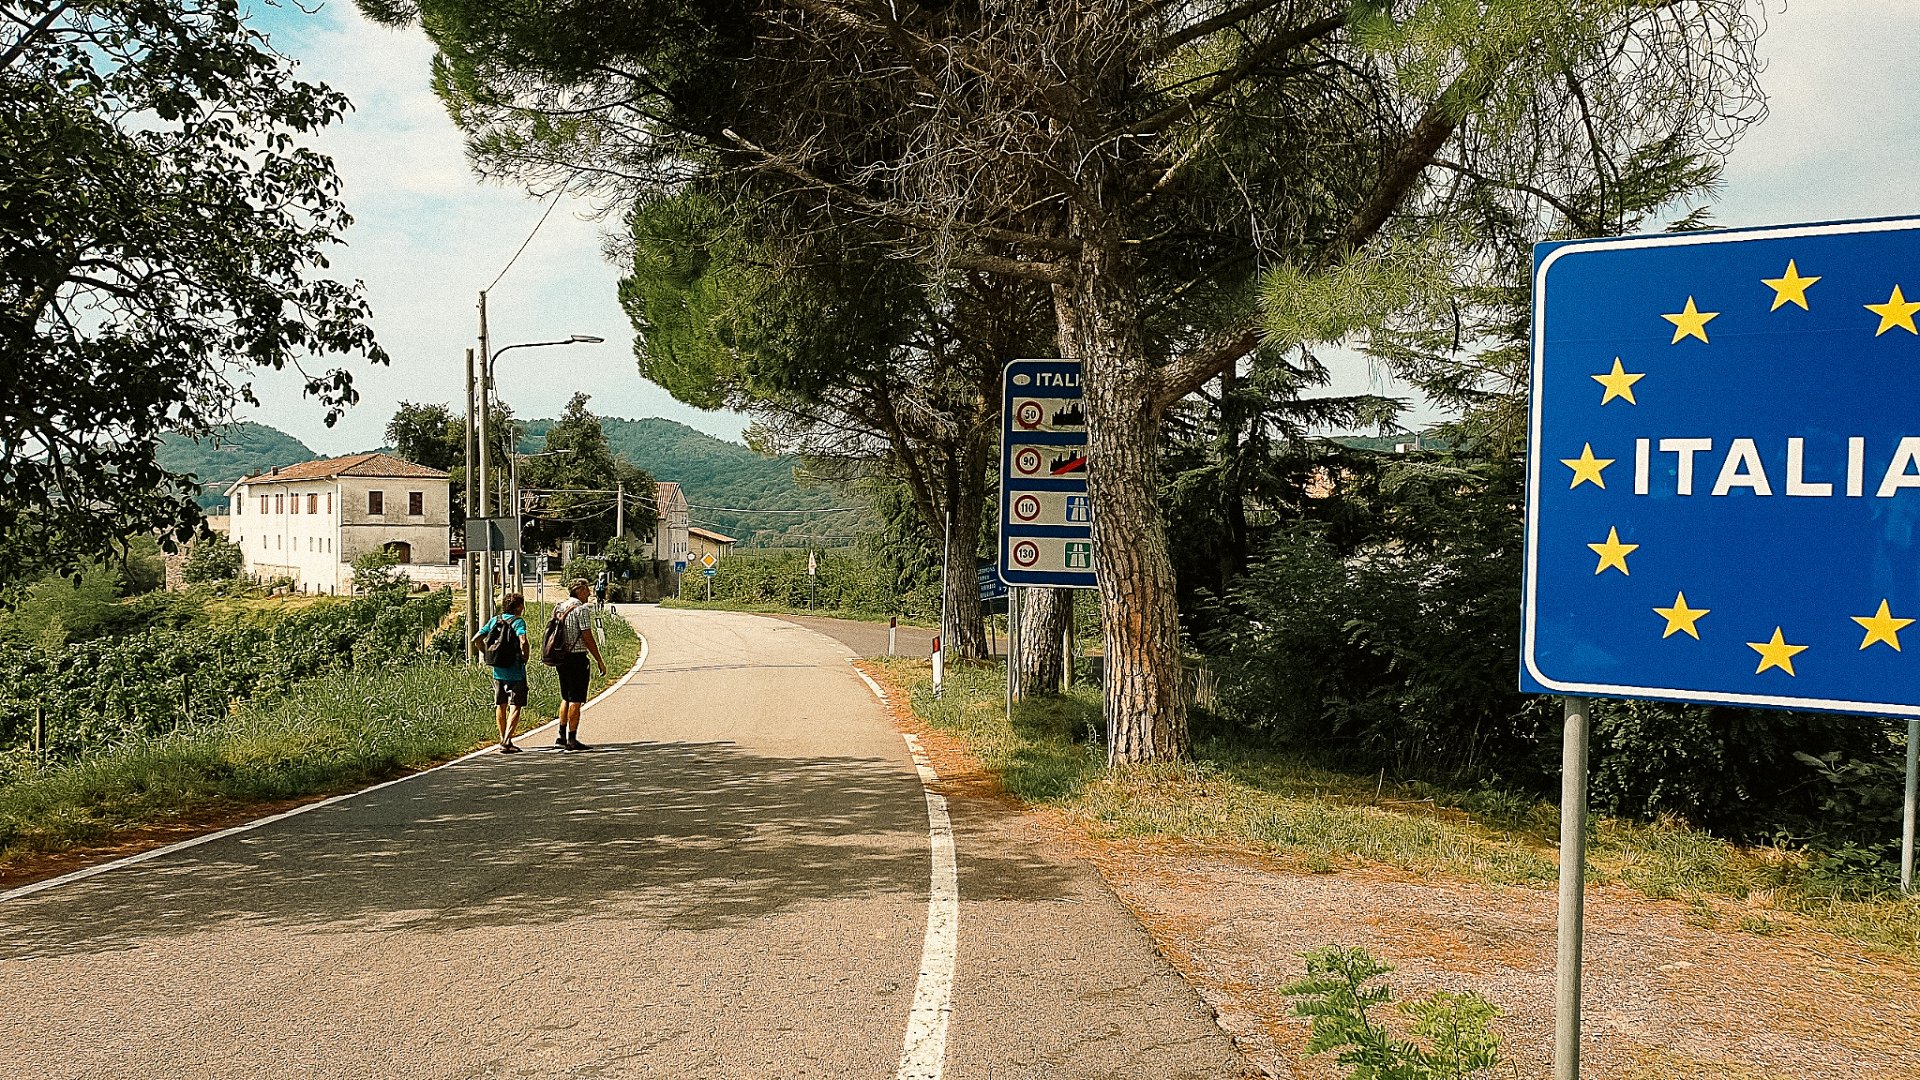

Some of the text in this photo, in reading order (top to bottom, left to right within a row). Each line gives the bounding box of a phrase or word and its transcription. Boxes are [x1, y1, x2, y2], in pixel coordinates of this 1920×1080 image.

[1036, 372, 1080, 387] ITALI
[1024, 409, 1037, 420] 50
[1023, 456, 1035, 467] 90
[1633, 436, 1920, 498] ITALIA
[1020, 503, 1034, 513] 110
[1018, 548, 1034, 559] 130
